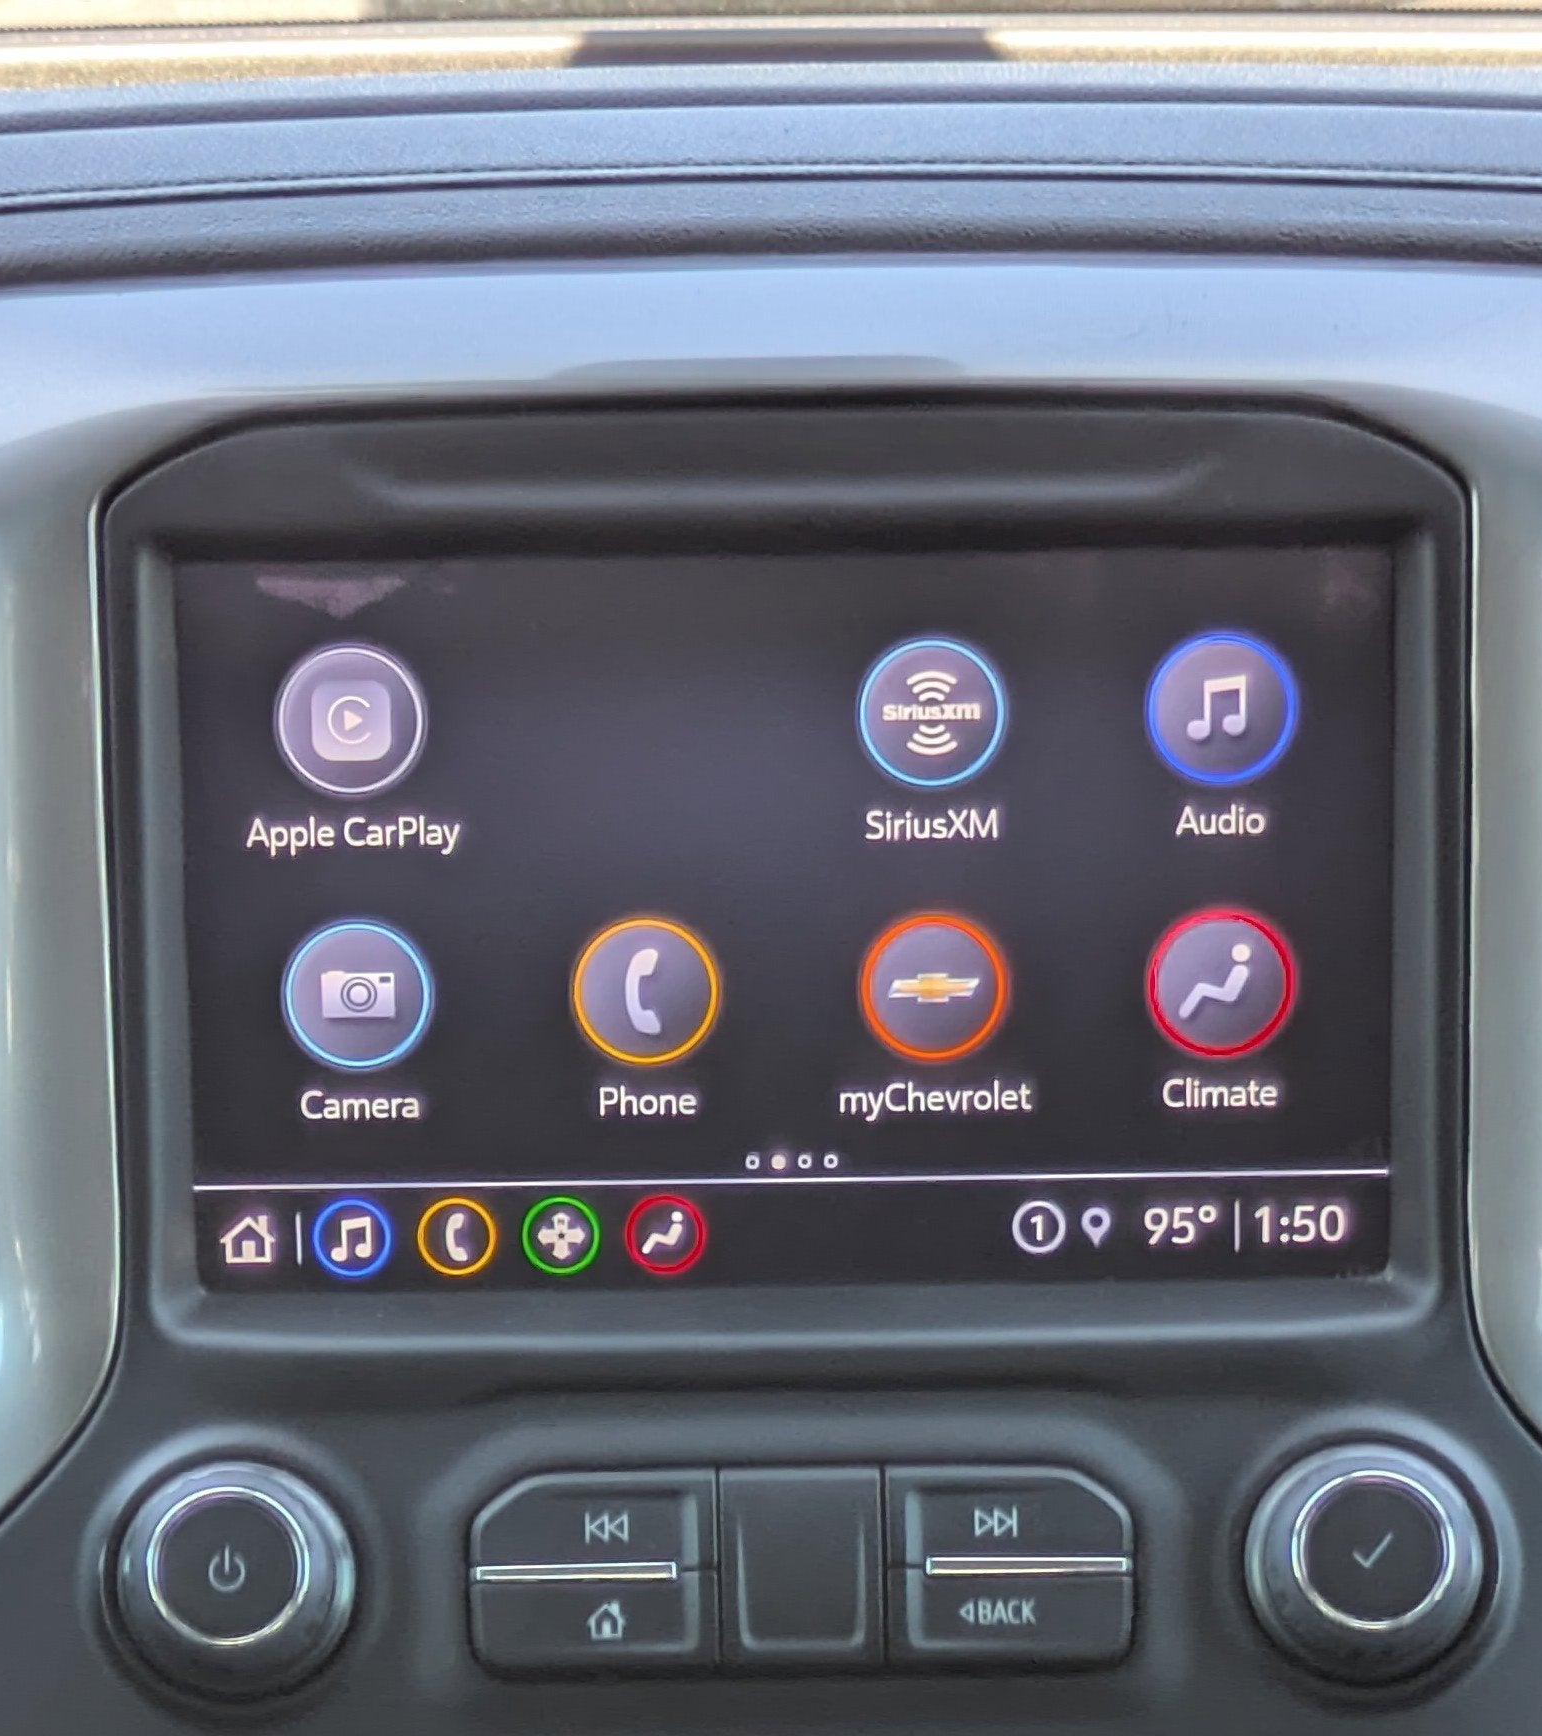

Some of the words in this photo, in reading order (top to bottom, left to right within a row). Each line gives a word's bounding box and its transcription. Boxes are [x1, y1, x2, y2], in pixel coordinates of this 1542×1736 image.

[245, 816, 338, 858] Apple
[342, 815, 461, 856] CarPlay
[864, 808, 1000, 842] SiriusXM
[1175, 802, 1267, 837] Audio
[299, 1089, 421, 1121] Camera
[598, 1083, 698, 1118] Phone
[838, 1079, 1033, 1121] myChevrolet
[1161, 1076, 1280, 1110] Climate
[1143, 1204, 1219, 1246] 95°
[1254, 1204, 1348, 1245] 1:50
[977, 1599, 1037, 1625] BACK
